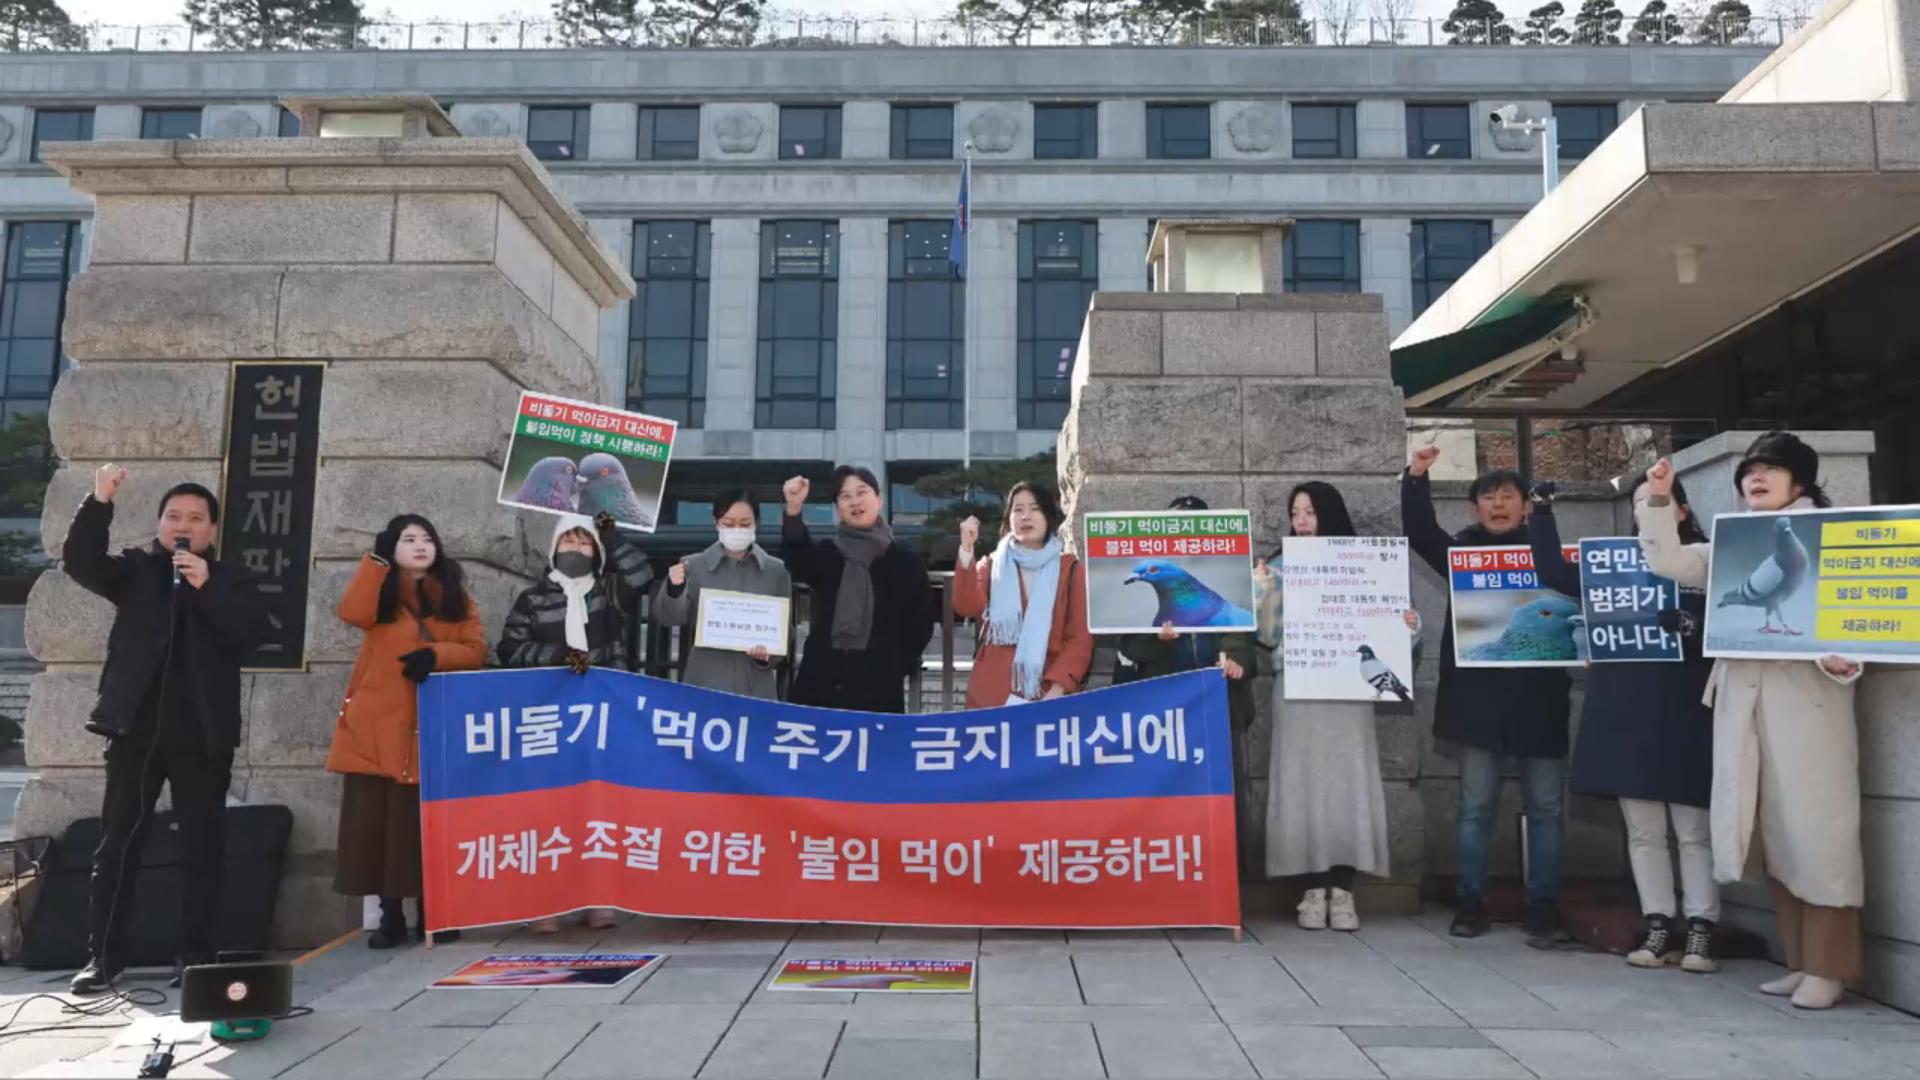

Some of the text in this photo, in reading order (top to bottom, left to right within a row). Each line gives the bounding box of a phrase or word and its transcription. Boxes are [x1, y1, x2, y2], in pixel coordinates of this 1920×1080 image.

[529, 402, 566, 420] 비둘기
[571, 409, 621, 432] 먹이금지
[580, 431, 605, 448] 정책
[608, 437, 663, 458] 시행하라!
[1090, 517, 1248, 535] 비둘기 먹이금지 대신에,
[1856, 527, 1897, 541] 비둘기
[1105, 538, 1236, 555] 불임 먹이 제공하라!
[1452, 551, 1535, 569] 비둘기 먹이
[1823, 556, 1875, 570] 먹이금지
[1471, 572, 1538, 588] 불임 먹이
[1588, 584, 1668, 613] 범죄가
[1841, 618, 1901, 633] 제공하라!
[1592, 624, 1677, 652] 아니다.
[465, 696, 1204, 771] 비둘기 '먹이 주기' 금지 대신에,
[456, 820, 1203, 885] 개체수 조절 위한 '불임 먹이' 제공하라!
